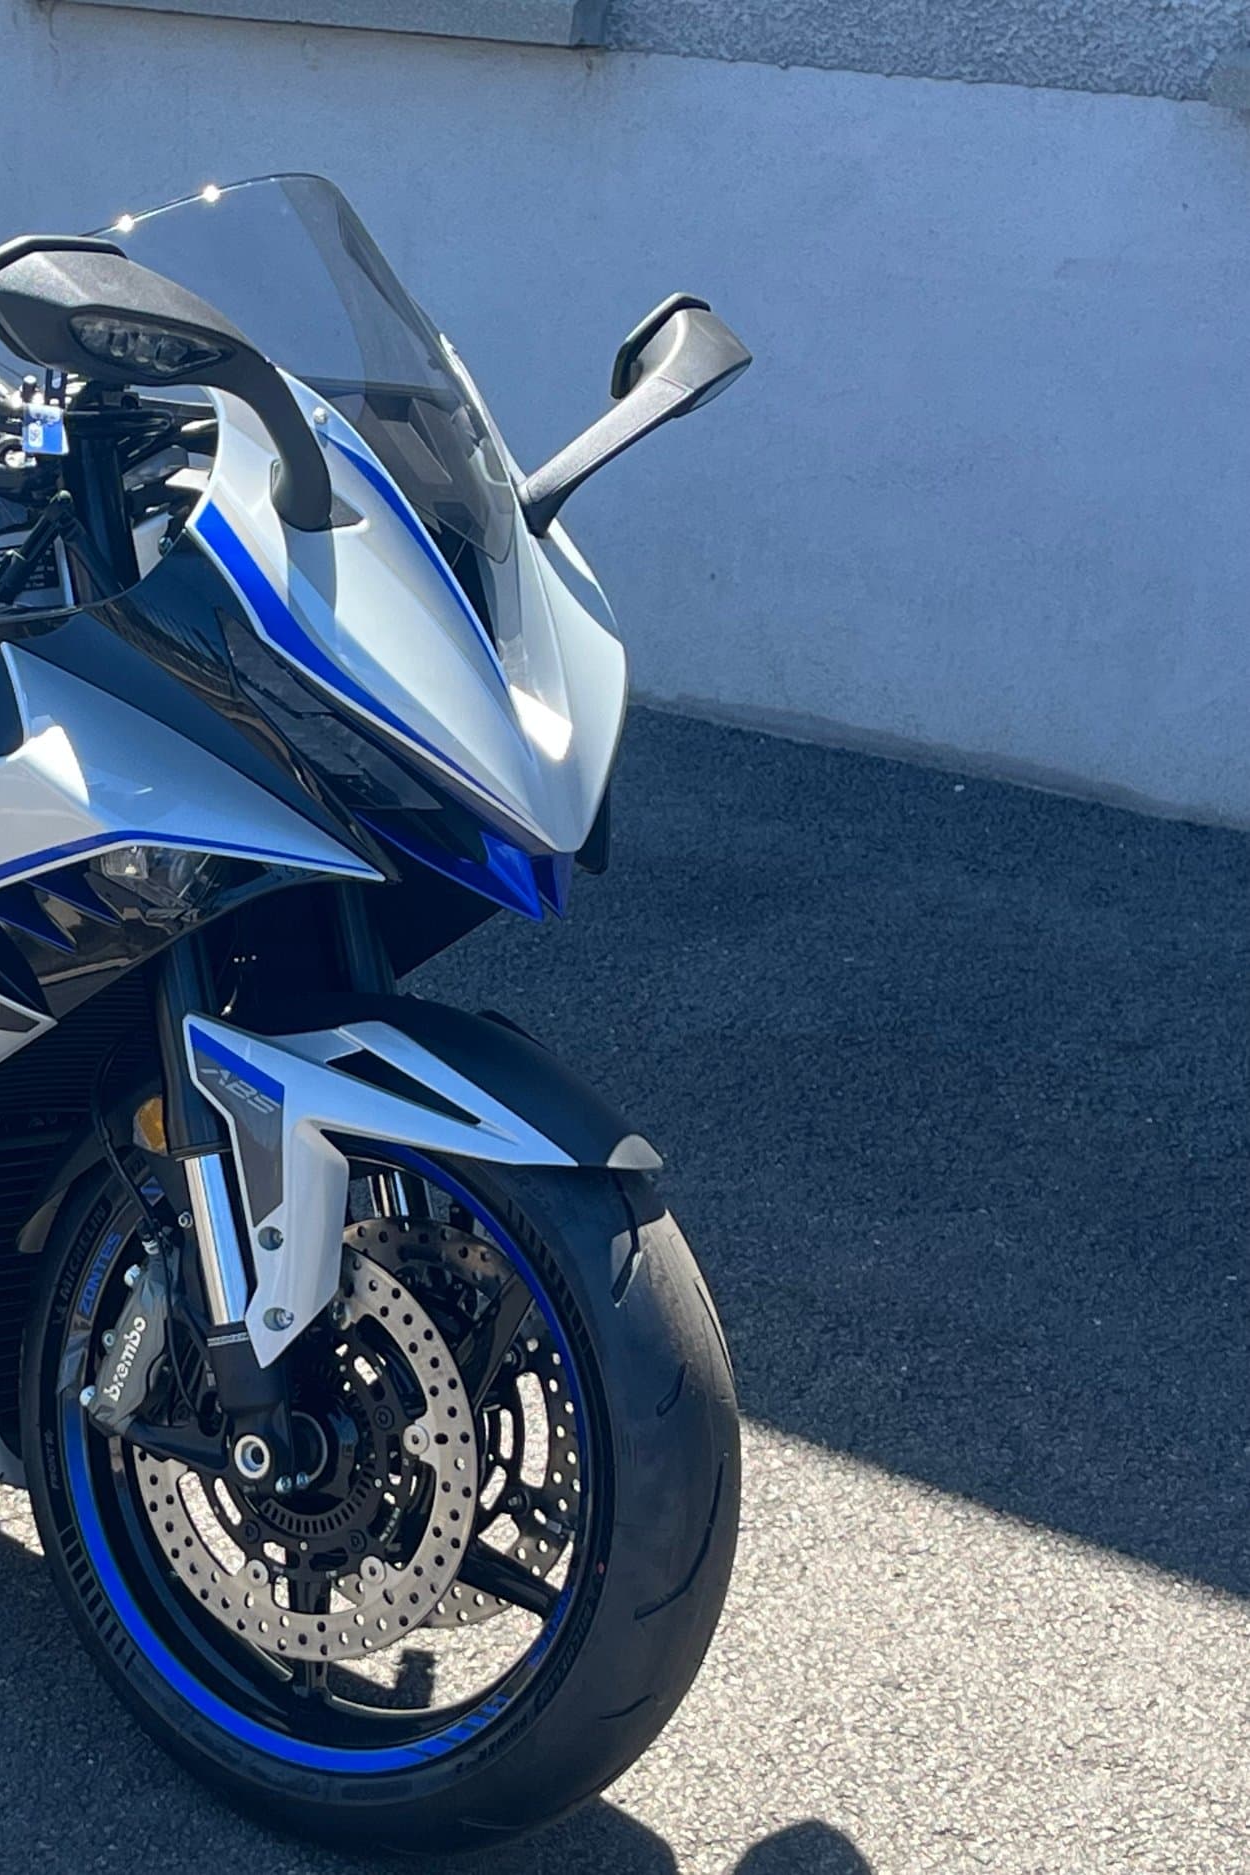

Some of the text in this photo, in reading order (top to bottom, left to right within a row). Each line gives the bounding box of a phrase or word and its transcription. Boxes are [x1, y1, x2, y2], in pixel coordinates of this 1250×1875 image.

[200, 1068, 282, 1114] ABS
[59, 1204, 107, 1299] MICHELIN
[78, 1232, 122, 1319] ZONTES
[103, 1316, 146, 1402] brembo
